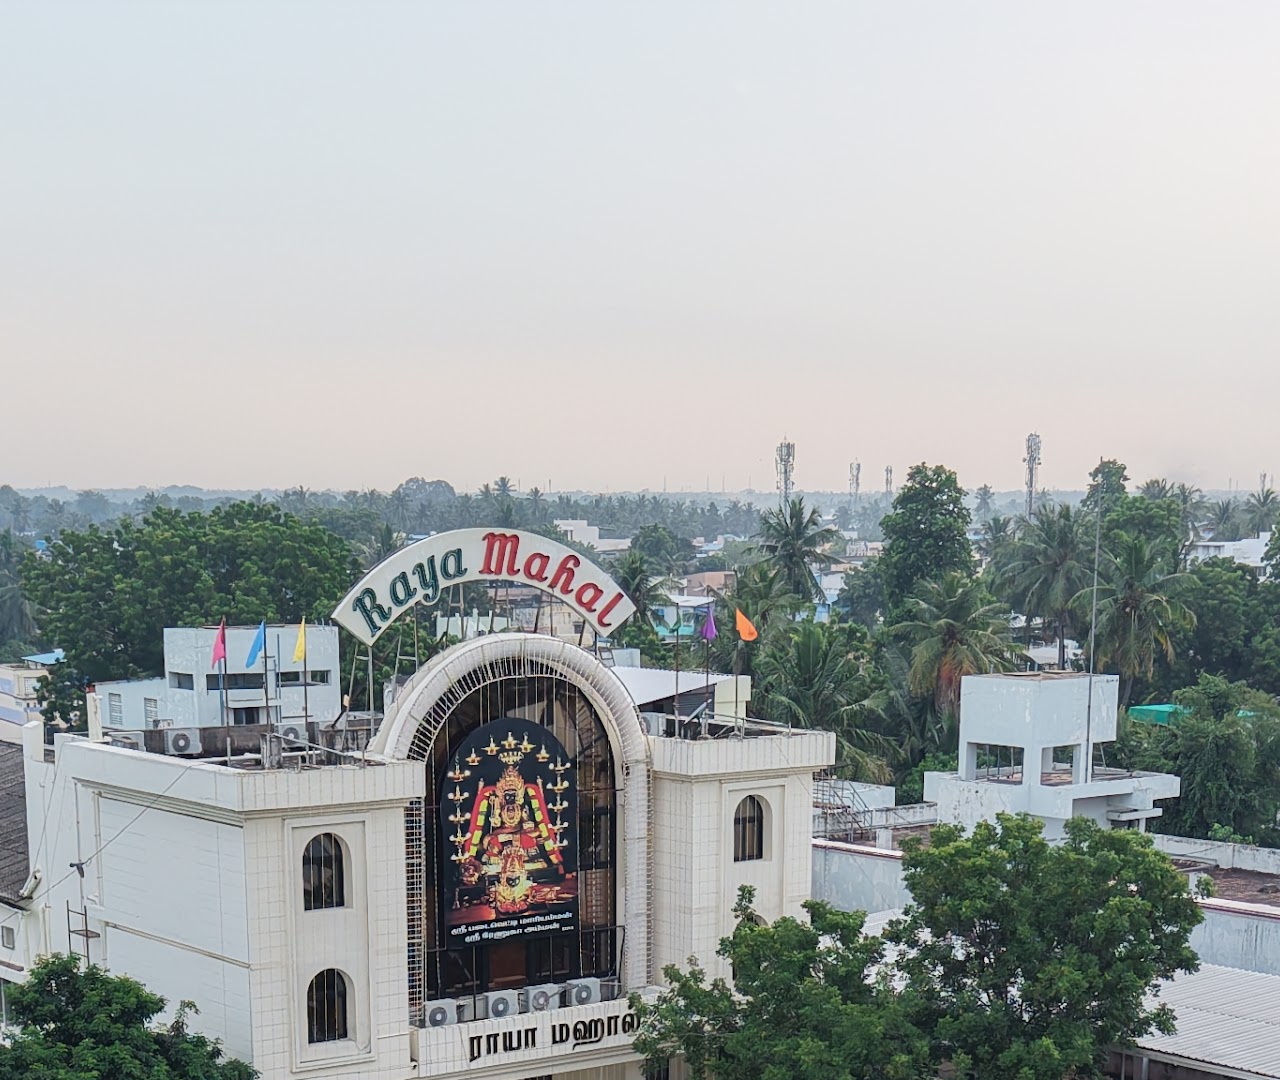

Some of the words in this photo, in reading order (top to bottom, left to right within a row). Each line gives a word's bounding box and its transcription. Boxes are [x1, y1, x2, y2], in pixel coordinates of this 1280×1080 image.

[352, 548, 468, 637] Raya
[479, 532, 624, 628] Mahal
[469, 1027, 538, 1062] ராயா
